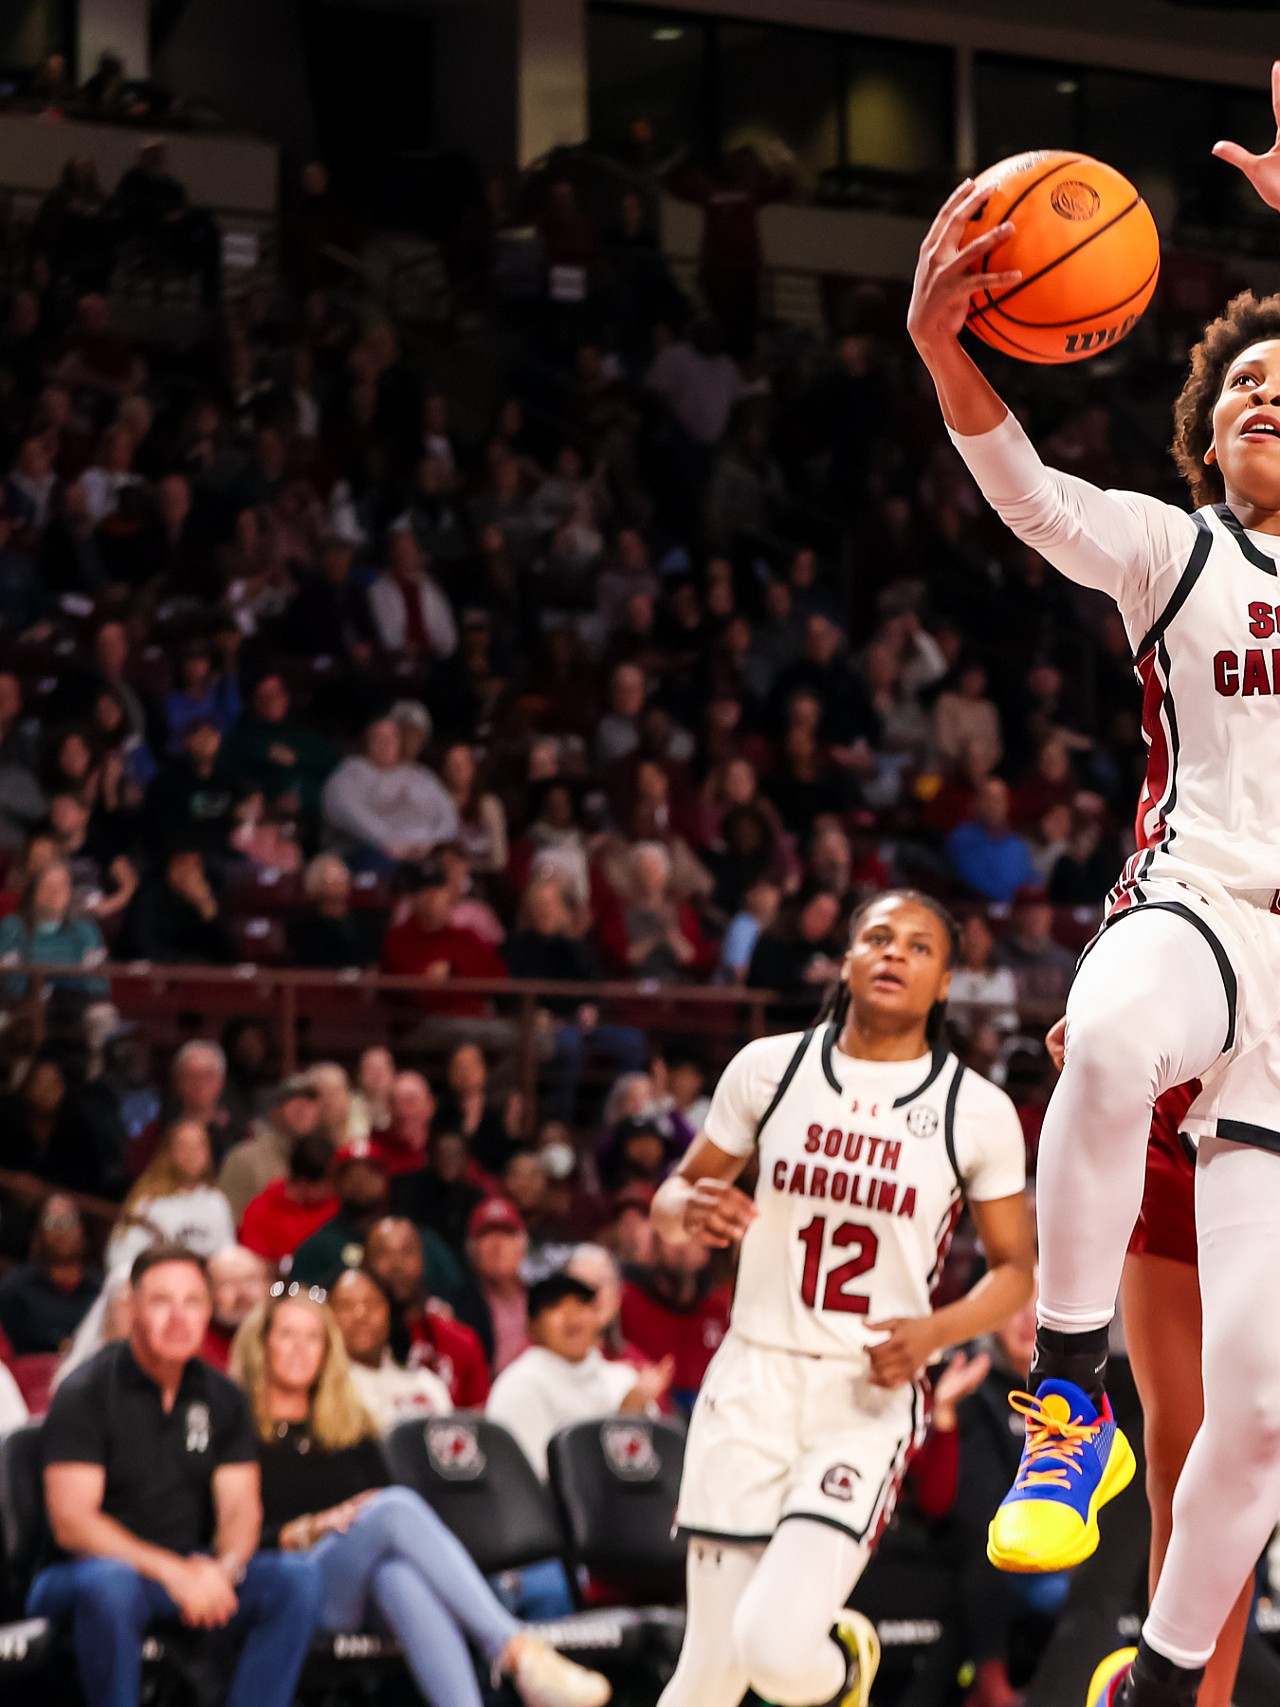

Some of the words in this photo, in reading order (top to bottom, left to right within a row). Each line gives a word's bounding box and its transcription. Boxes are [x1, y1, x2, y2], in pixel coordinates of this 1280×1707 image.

[804, 1123, 902, 1170] SOUTH
[772, 1160, 917, 1219] CAROLINA
[798, 1215, 879, 1315] 12
